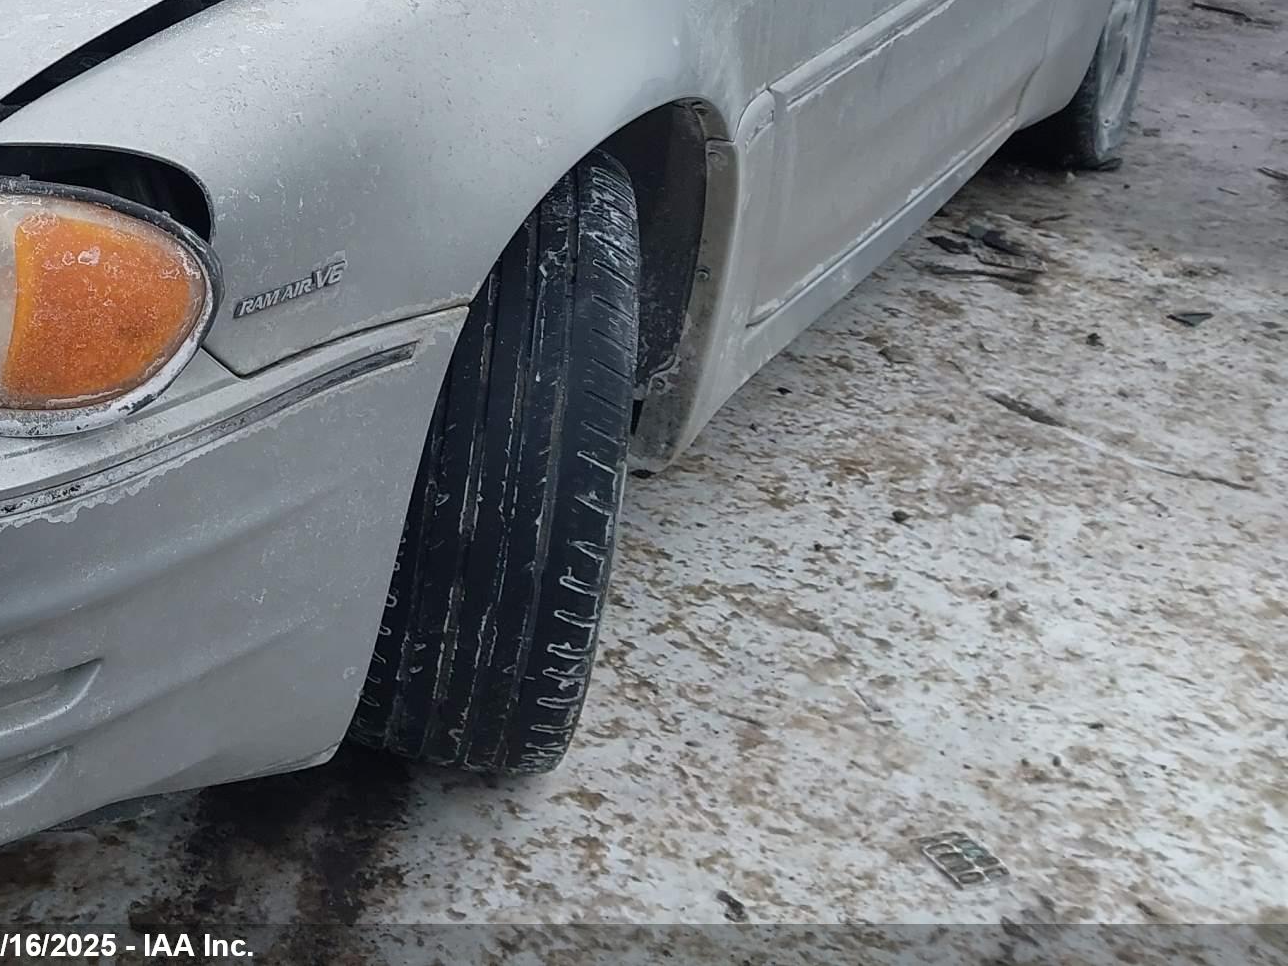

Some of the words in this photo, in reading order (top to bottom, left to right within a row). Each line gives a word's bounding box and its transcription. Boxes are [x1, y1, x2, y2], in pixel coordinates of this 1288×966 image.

[238, 288, 280, 317] RAM
[281, 277, 313, 302] AIR
[314, 260, 348, 291] V6
